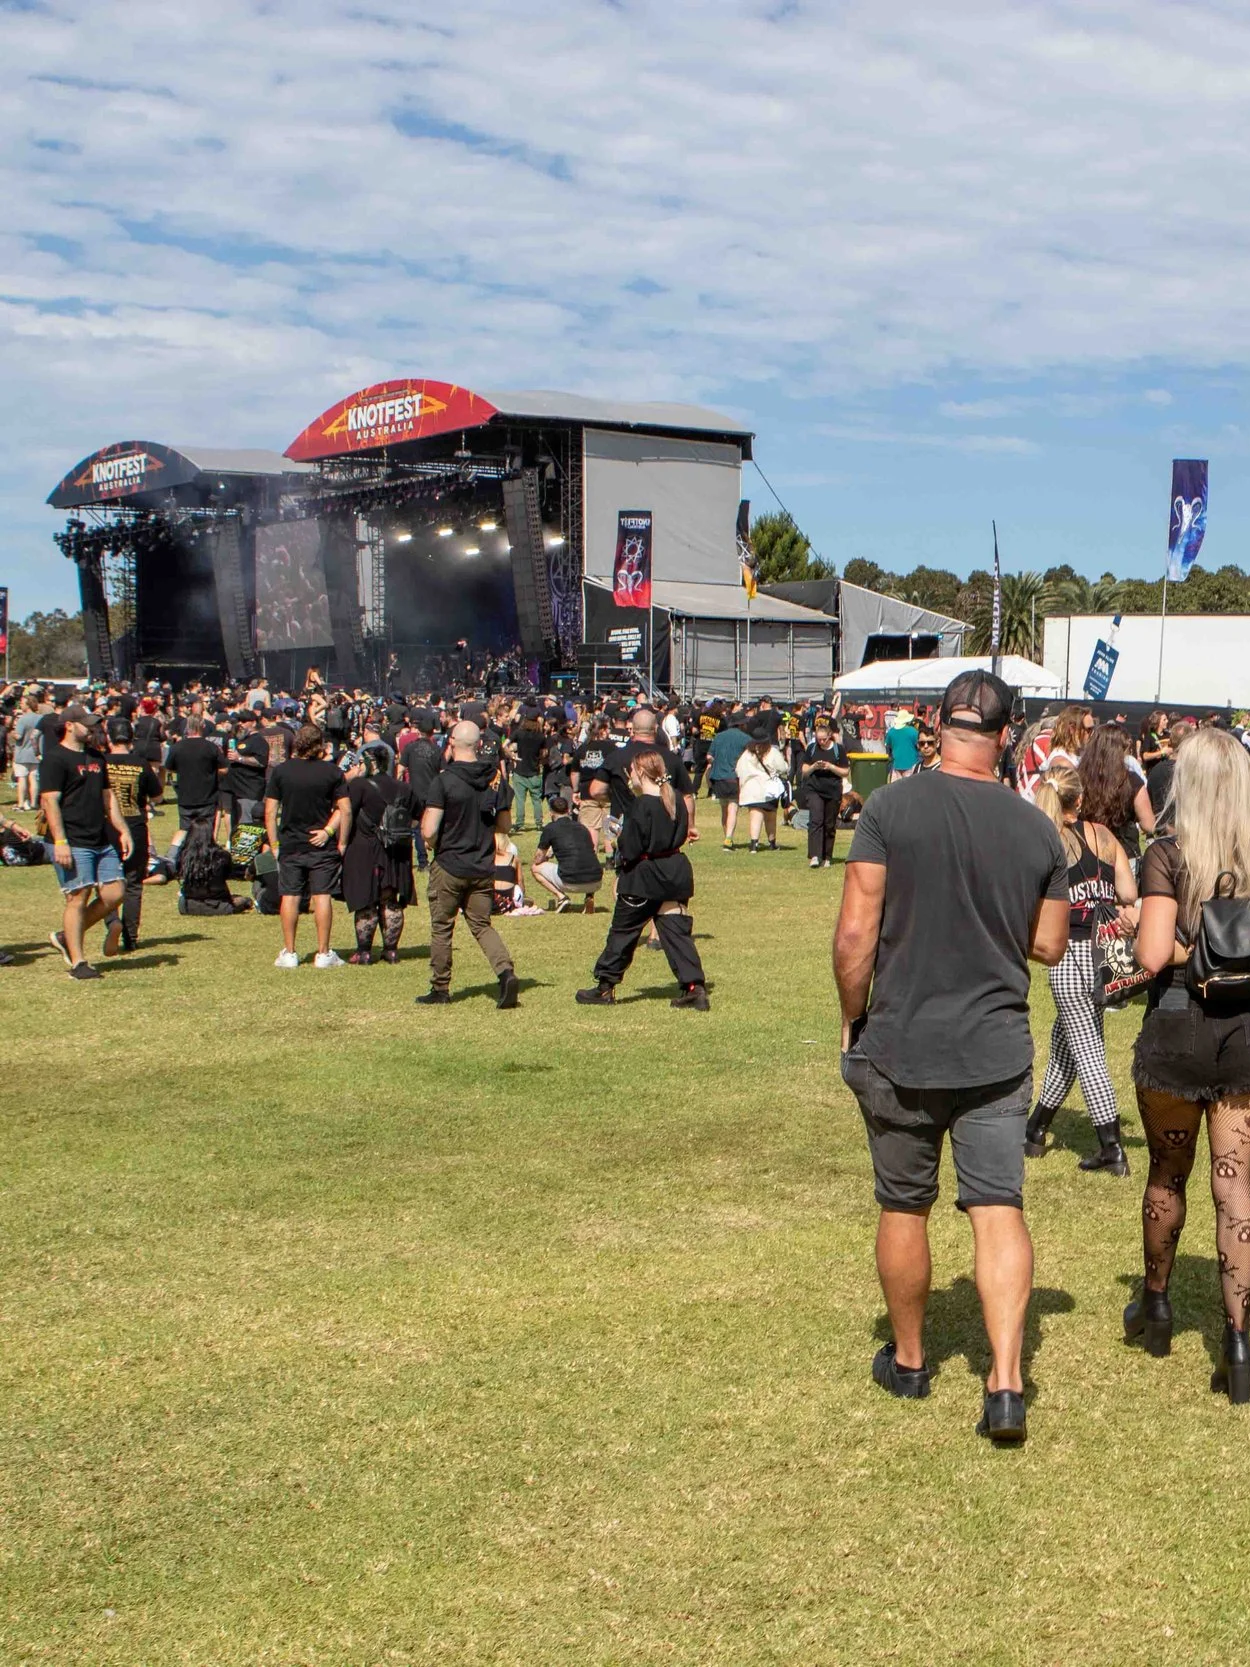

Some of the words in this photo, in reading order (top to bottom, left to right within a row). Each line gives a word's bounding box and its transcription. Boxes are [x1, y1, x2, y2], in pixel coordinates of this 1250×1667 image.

[348, 393, 423, 431] KNOTFEST
[356, 420, 414, 440] AUSTRALIA
[92, 453, 147, 483] KNOTFEST
[99, 476, 141, 492] AUSTRALIA
